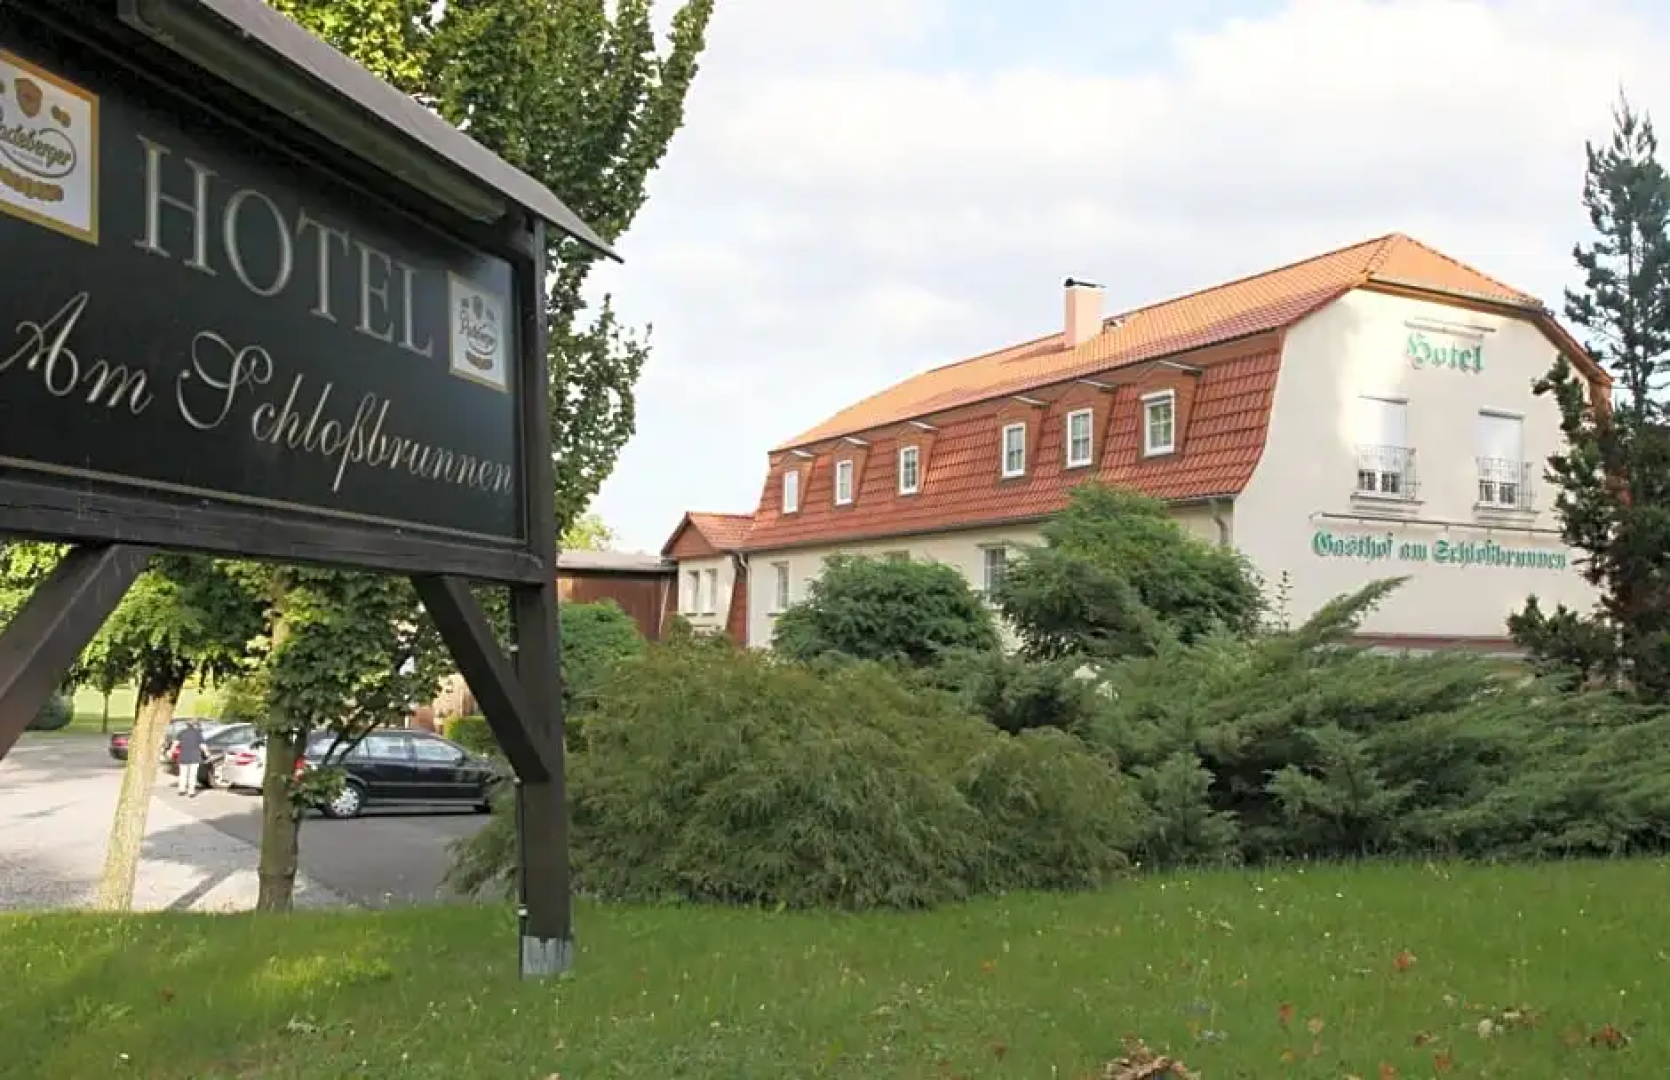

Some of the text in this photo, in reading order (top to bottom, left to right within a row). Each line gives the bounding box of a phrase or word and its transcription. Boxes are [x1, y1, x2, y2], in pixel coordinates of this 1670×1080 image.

[0, 123, 72, 170] adeberger
[135, 134, 434, 358] HOTEL
[1406, 333, 1485, 373] Hotel
[0, 291, 512, 493] Am Schloßbrunnen
[1311, 530, 1568, 570] Gasthof am Schloßbrunnen
